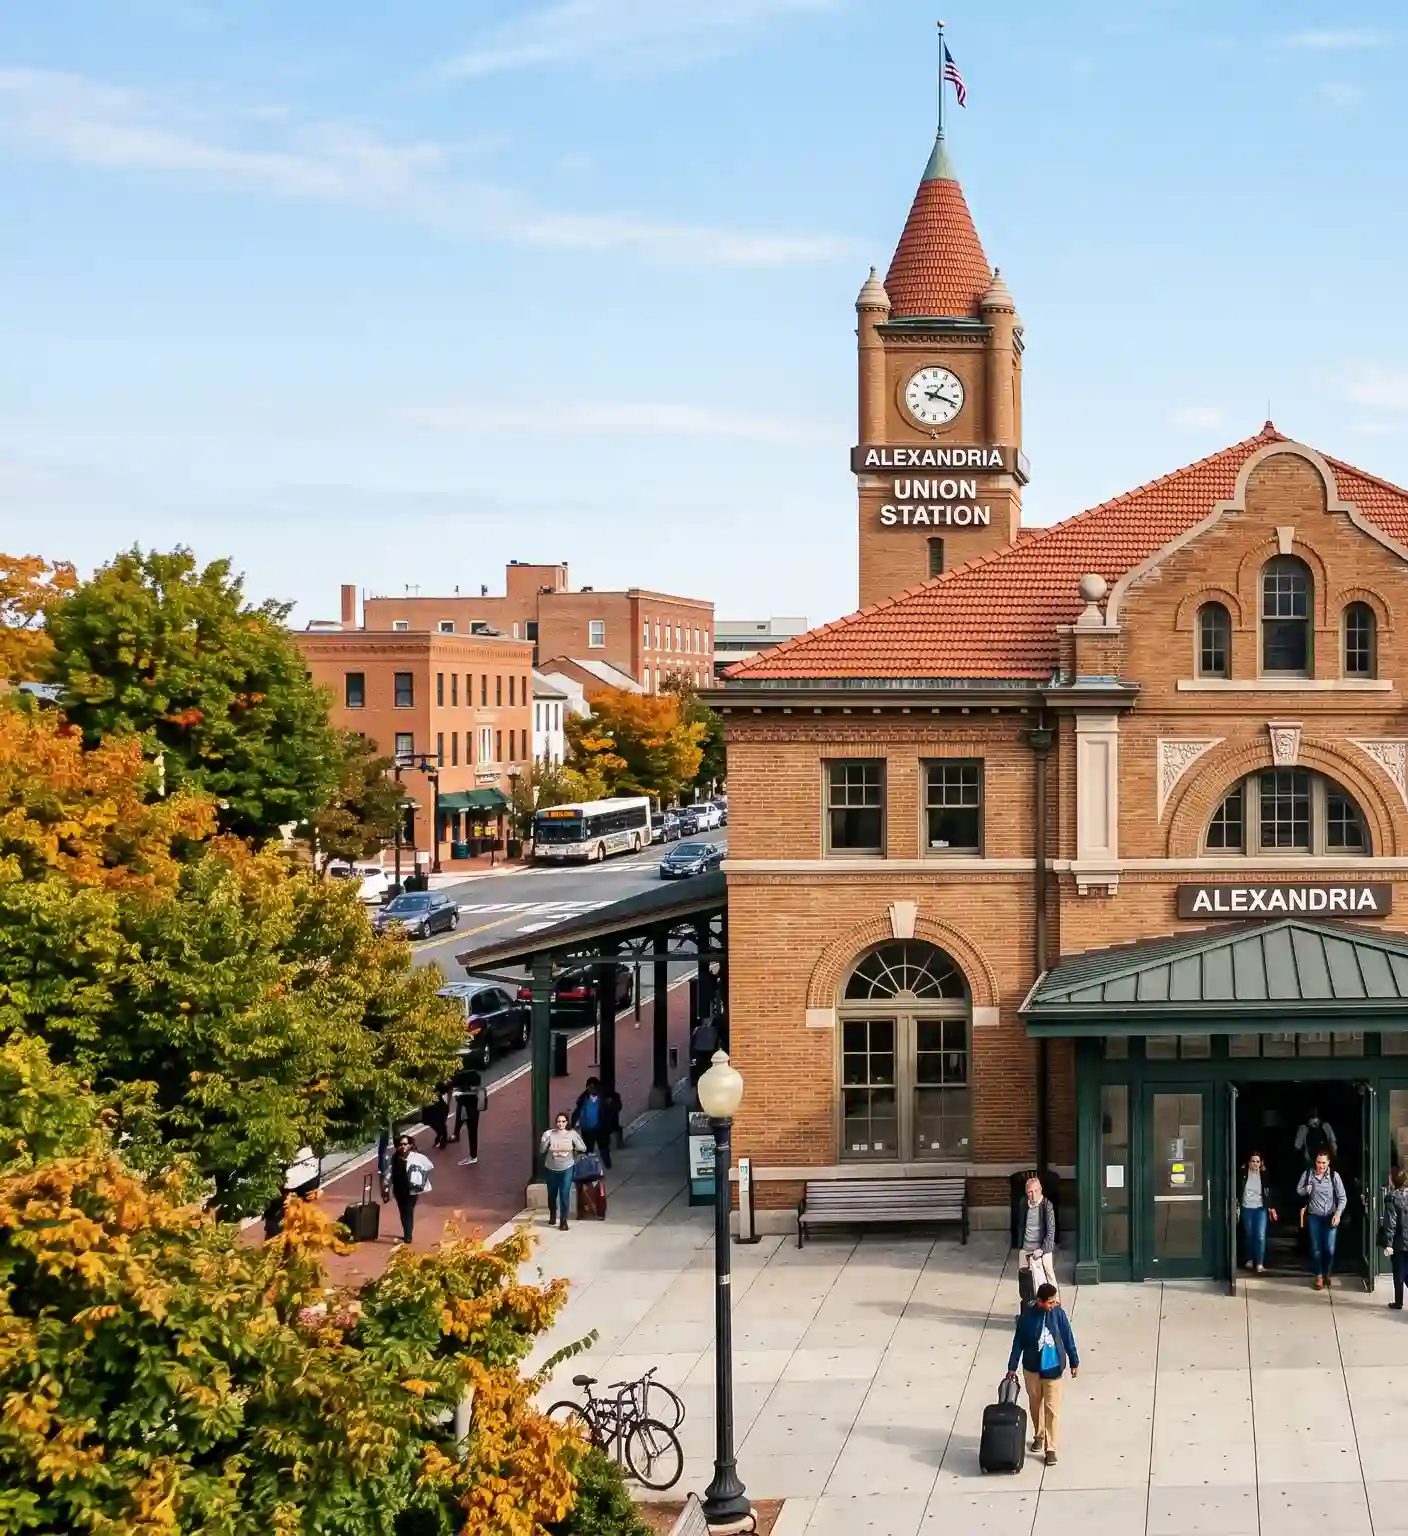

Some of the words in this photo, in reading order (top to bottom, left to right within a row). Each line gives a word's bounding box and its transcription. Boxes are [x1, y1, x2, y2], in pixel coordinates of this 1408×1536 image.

[865, 449, 1004, 466] ALEXANDRIA
[894, 479, 976, 499] UNION
[880, 505, 990, 525] STATION
[1192, 888, 1378, 912] ALEXANDRIA
